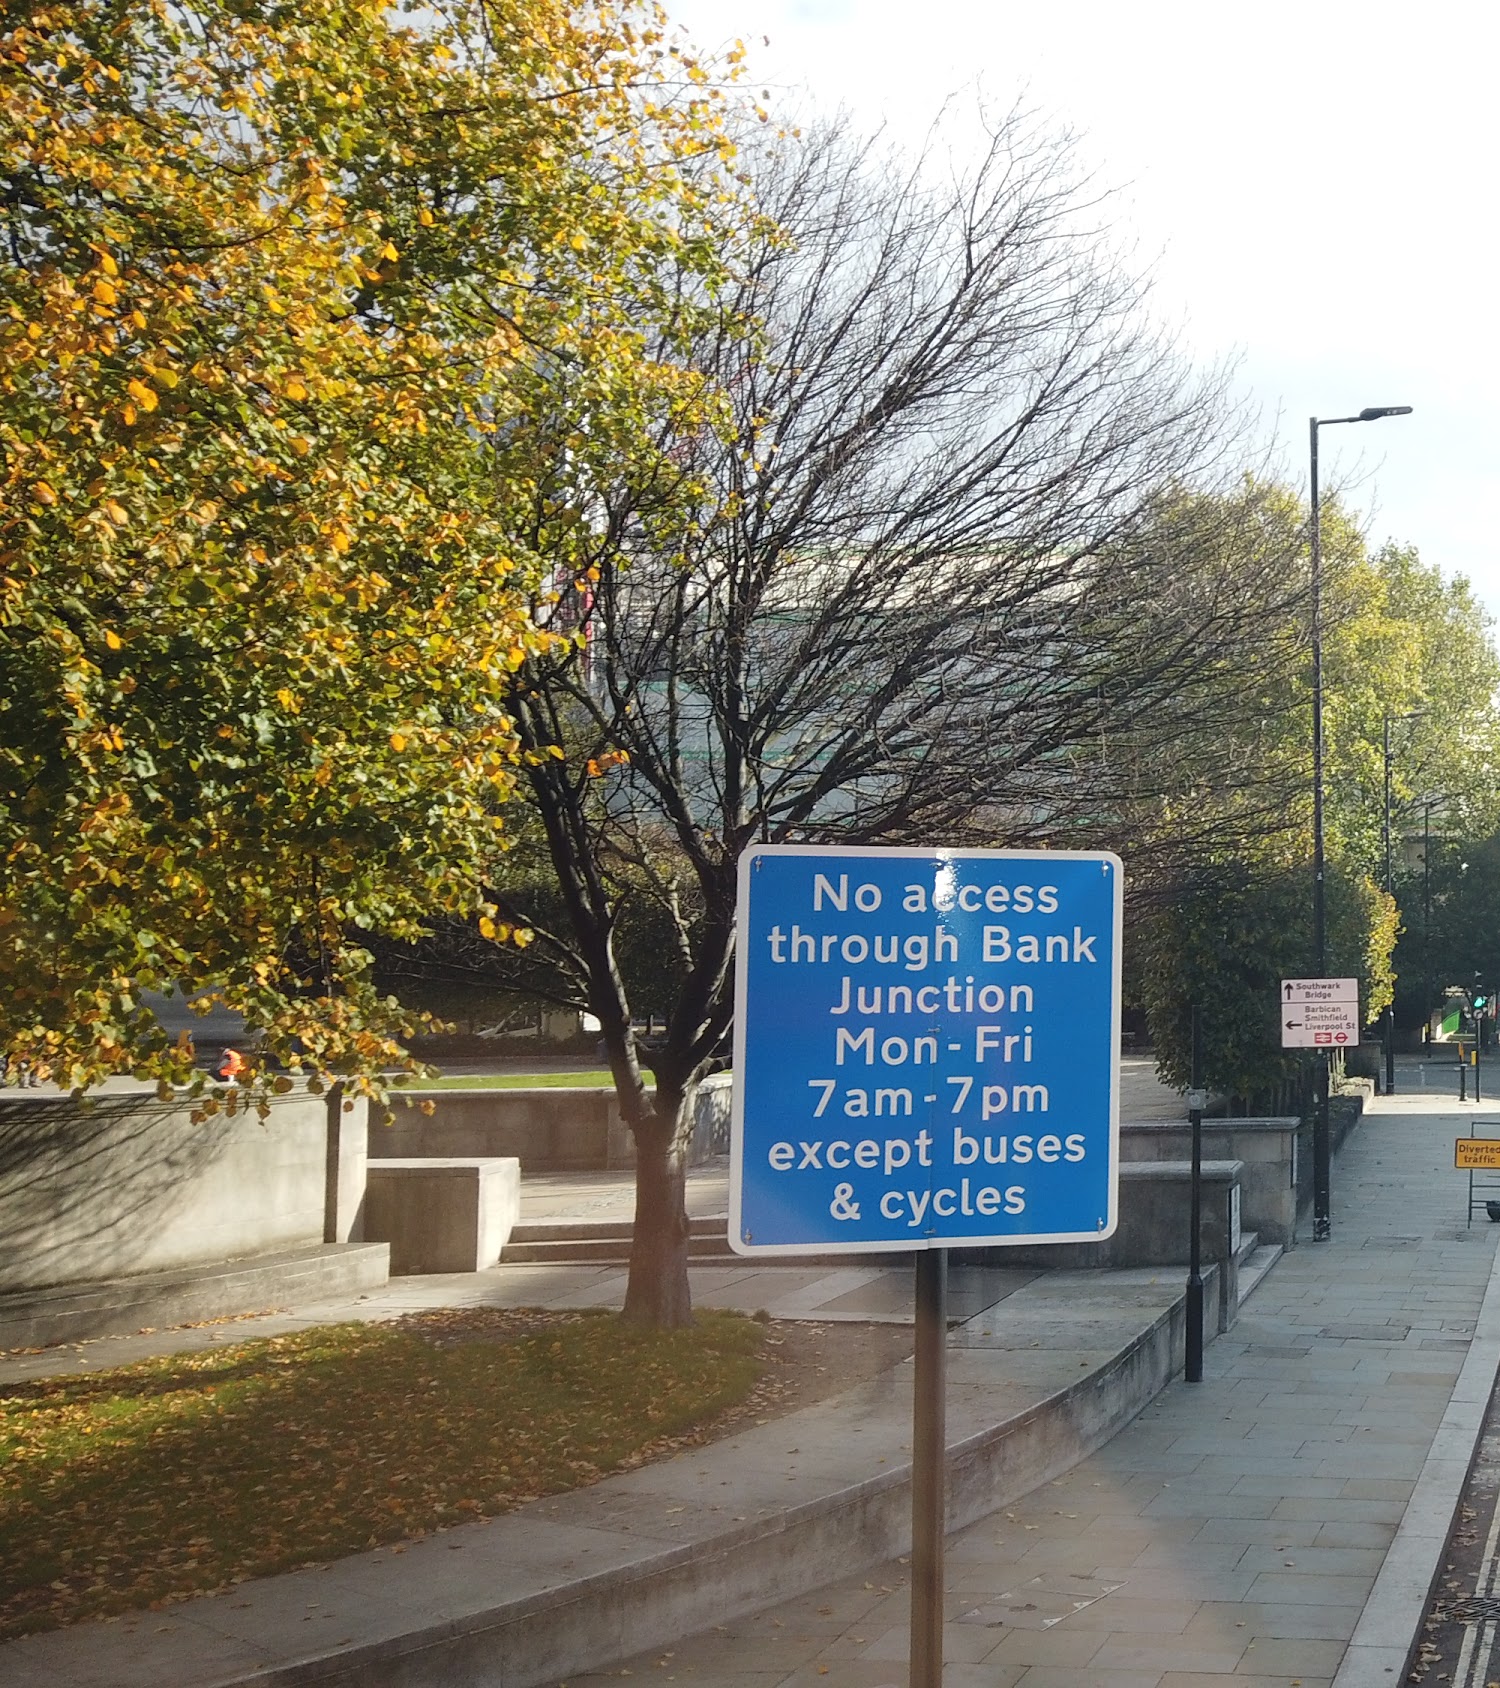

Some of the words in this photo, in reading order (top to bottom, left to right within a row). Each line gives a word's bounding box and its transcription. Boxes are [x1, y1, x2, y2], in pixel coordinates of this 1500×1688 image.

[813, 873, 881, 912] No
[902, 884, 1059, 914] access
[767, 925, 958, 971] through
[982, 925, 1097, 963] Bank
[830, 975, 1033, 1014] Junction
[1305, 1023, 1343, 1031] Liverpool
[769, 1129, 933, 1175] except
[953, 1127, 1086, 1165] buses
[1464, 1155, 1496, 1163] traffic
[829, 1183, 861, 1221] &
[880, 1179, 1026, 1227] cycles
